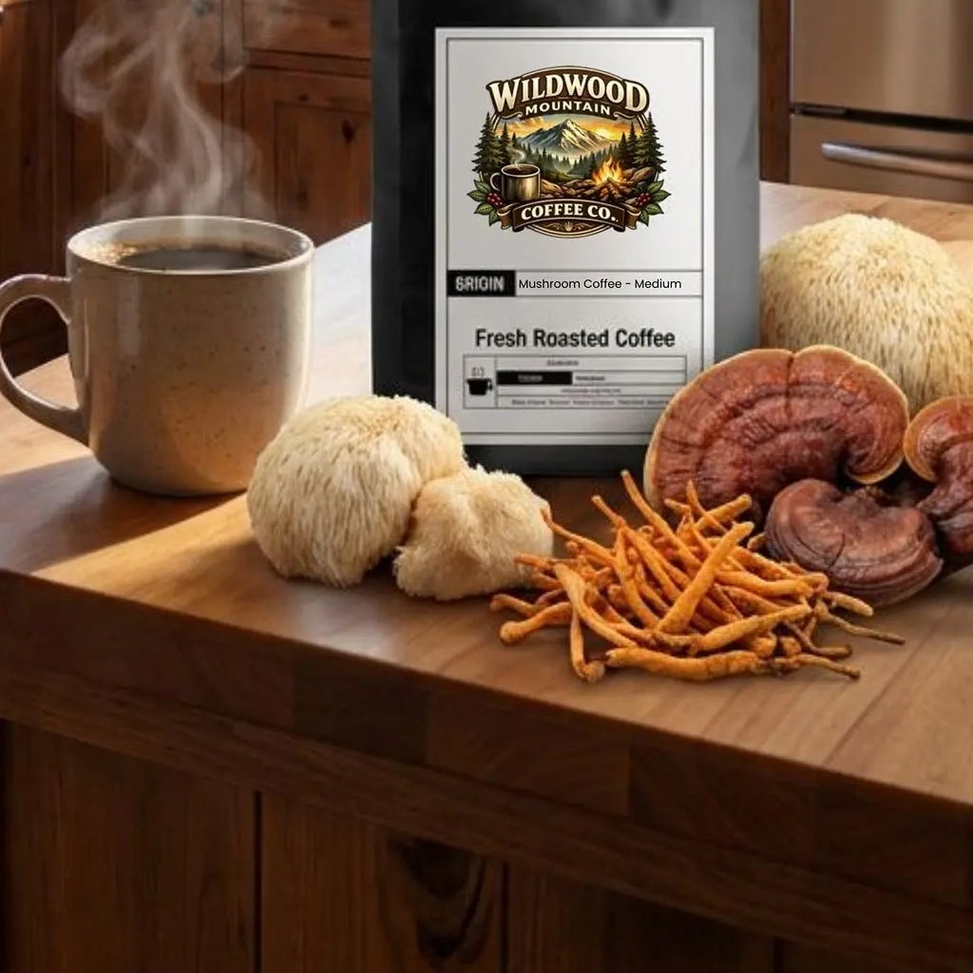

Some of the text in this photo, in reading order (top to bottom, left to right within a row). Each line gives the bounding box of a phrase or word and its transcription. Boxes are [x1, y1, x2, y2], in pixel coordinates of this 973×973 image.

[489, 74, 647, 112] WILDWOOD
[525, 101, 611, 115] MOUNTAIN
[521, 204, 583, 220] COFFEE
[518, 277, 581, 290] Mushroom
[583, 277, 623, 290] Coffee
[634, 277, 682, 290] Medium
[475, 328, 676, 347] Fresh Roasted Coffee
